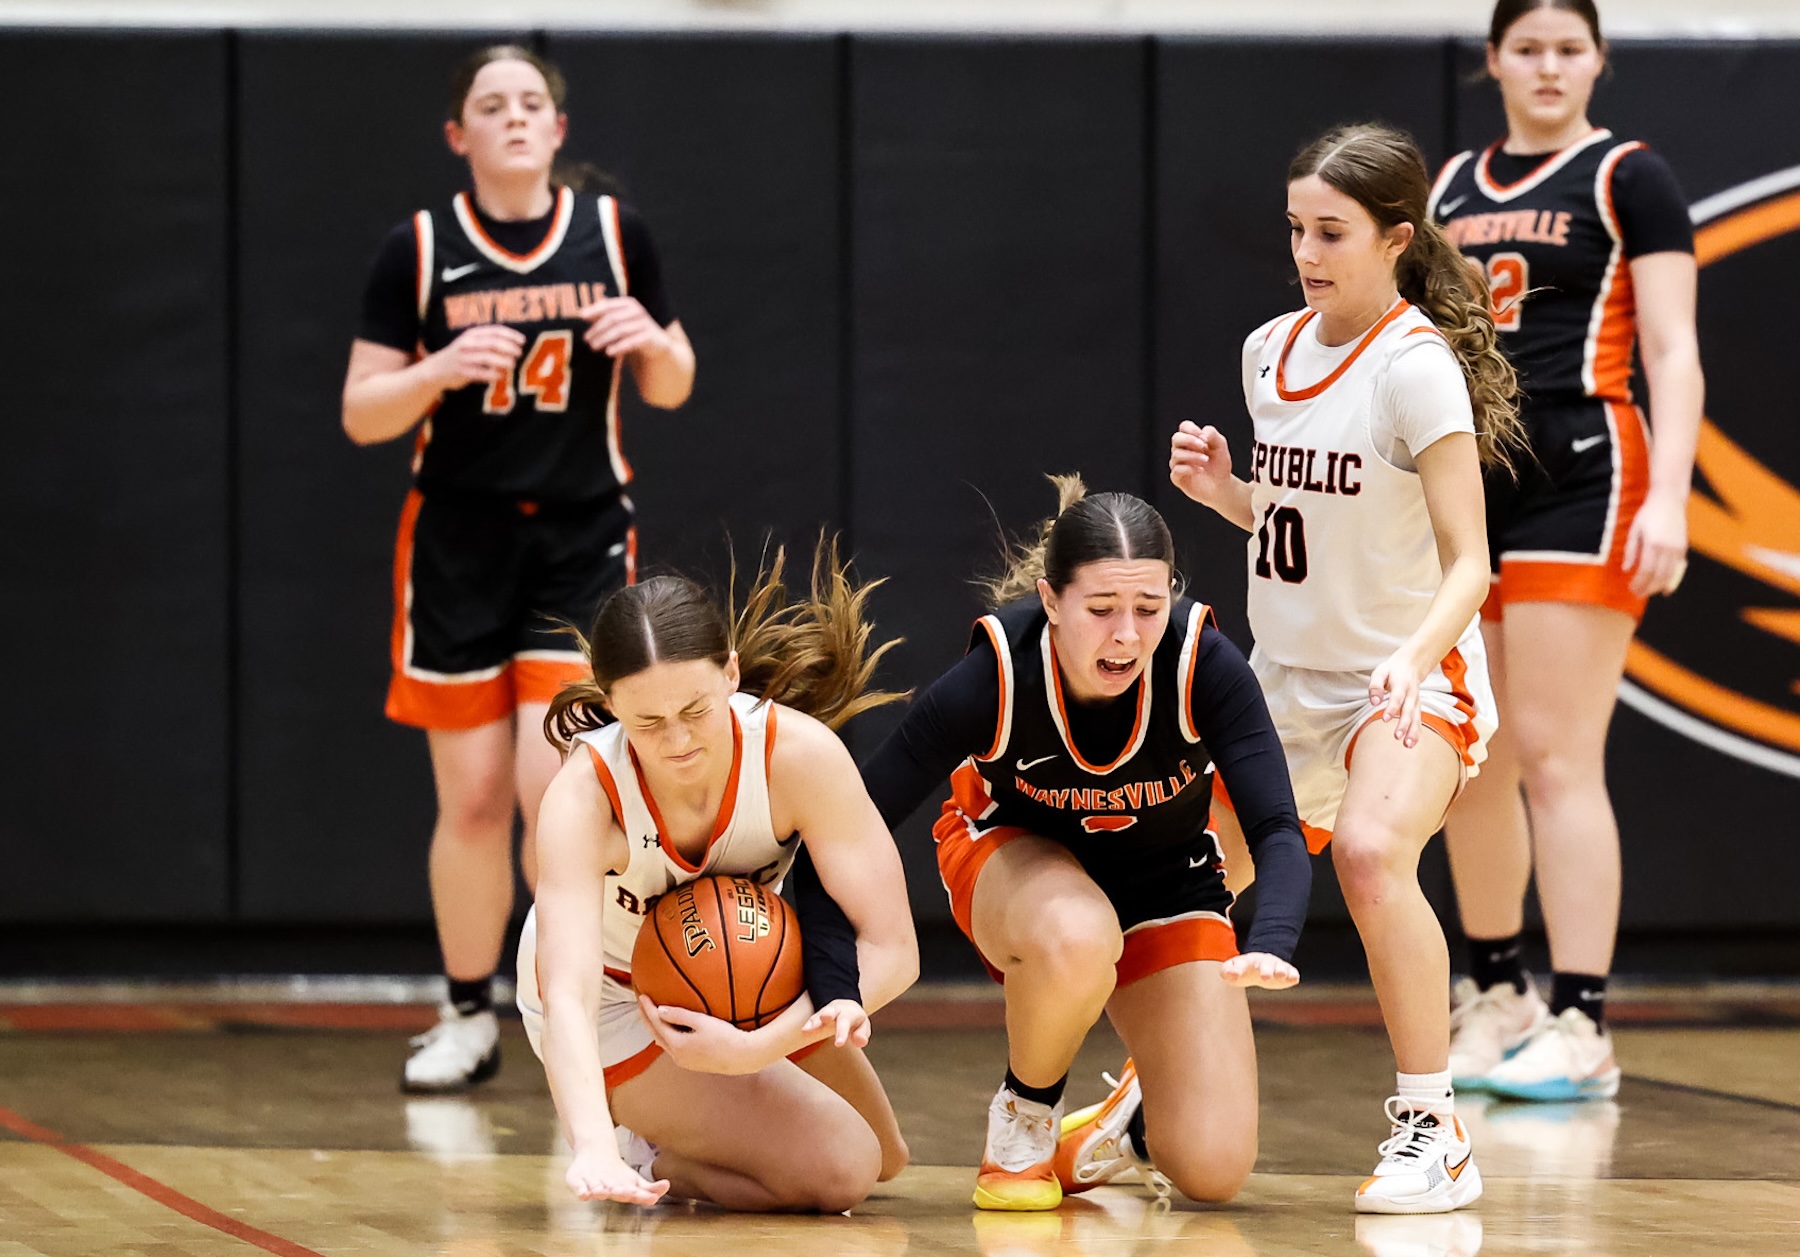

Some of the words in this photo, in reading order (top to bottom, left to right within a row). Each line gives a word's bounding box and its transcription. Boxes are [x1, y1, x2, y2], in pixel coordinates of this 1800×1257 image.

[1445, 208, 1573, 247] YNESVILLE
[1465, 251, 1530, 332] 2
[482, 329, 574, 415] 14
[1251, 440, 1362, 497] PUBLIC
[1255, 501, 1308, 585] 10
[1014, 759, 1197, 811] WAYNESVILLE
[676, 884, 716, 958] SPALDI
[731, 878, 757, 943] LEGAC
